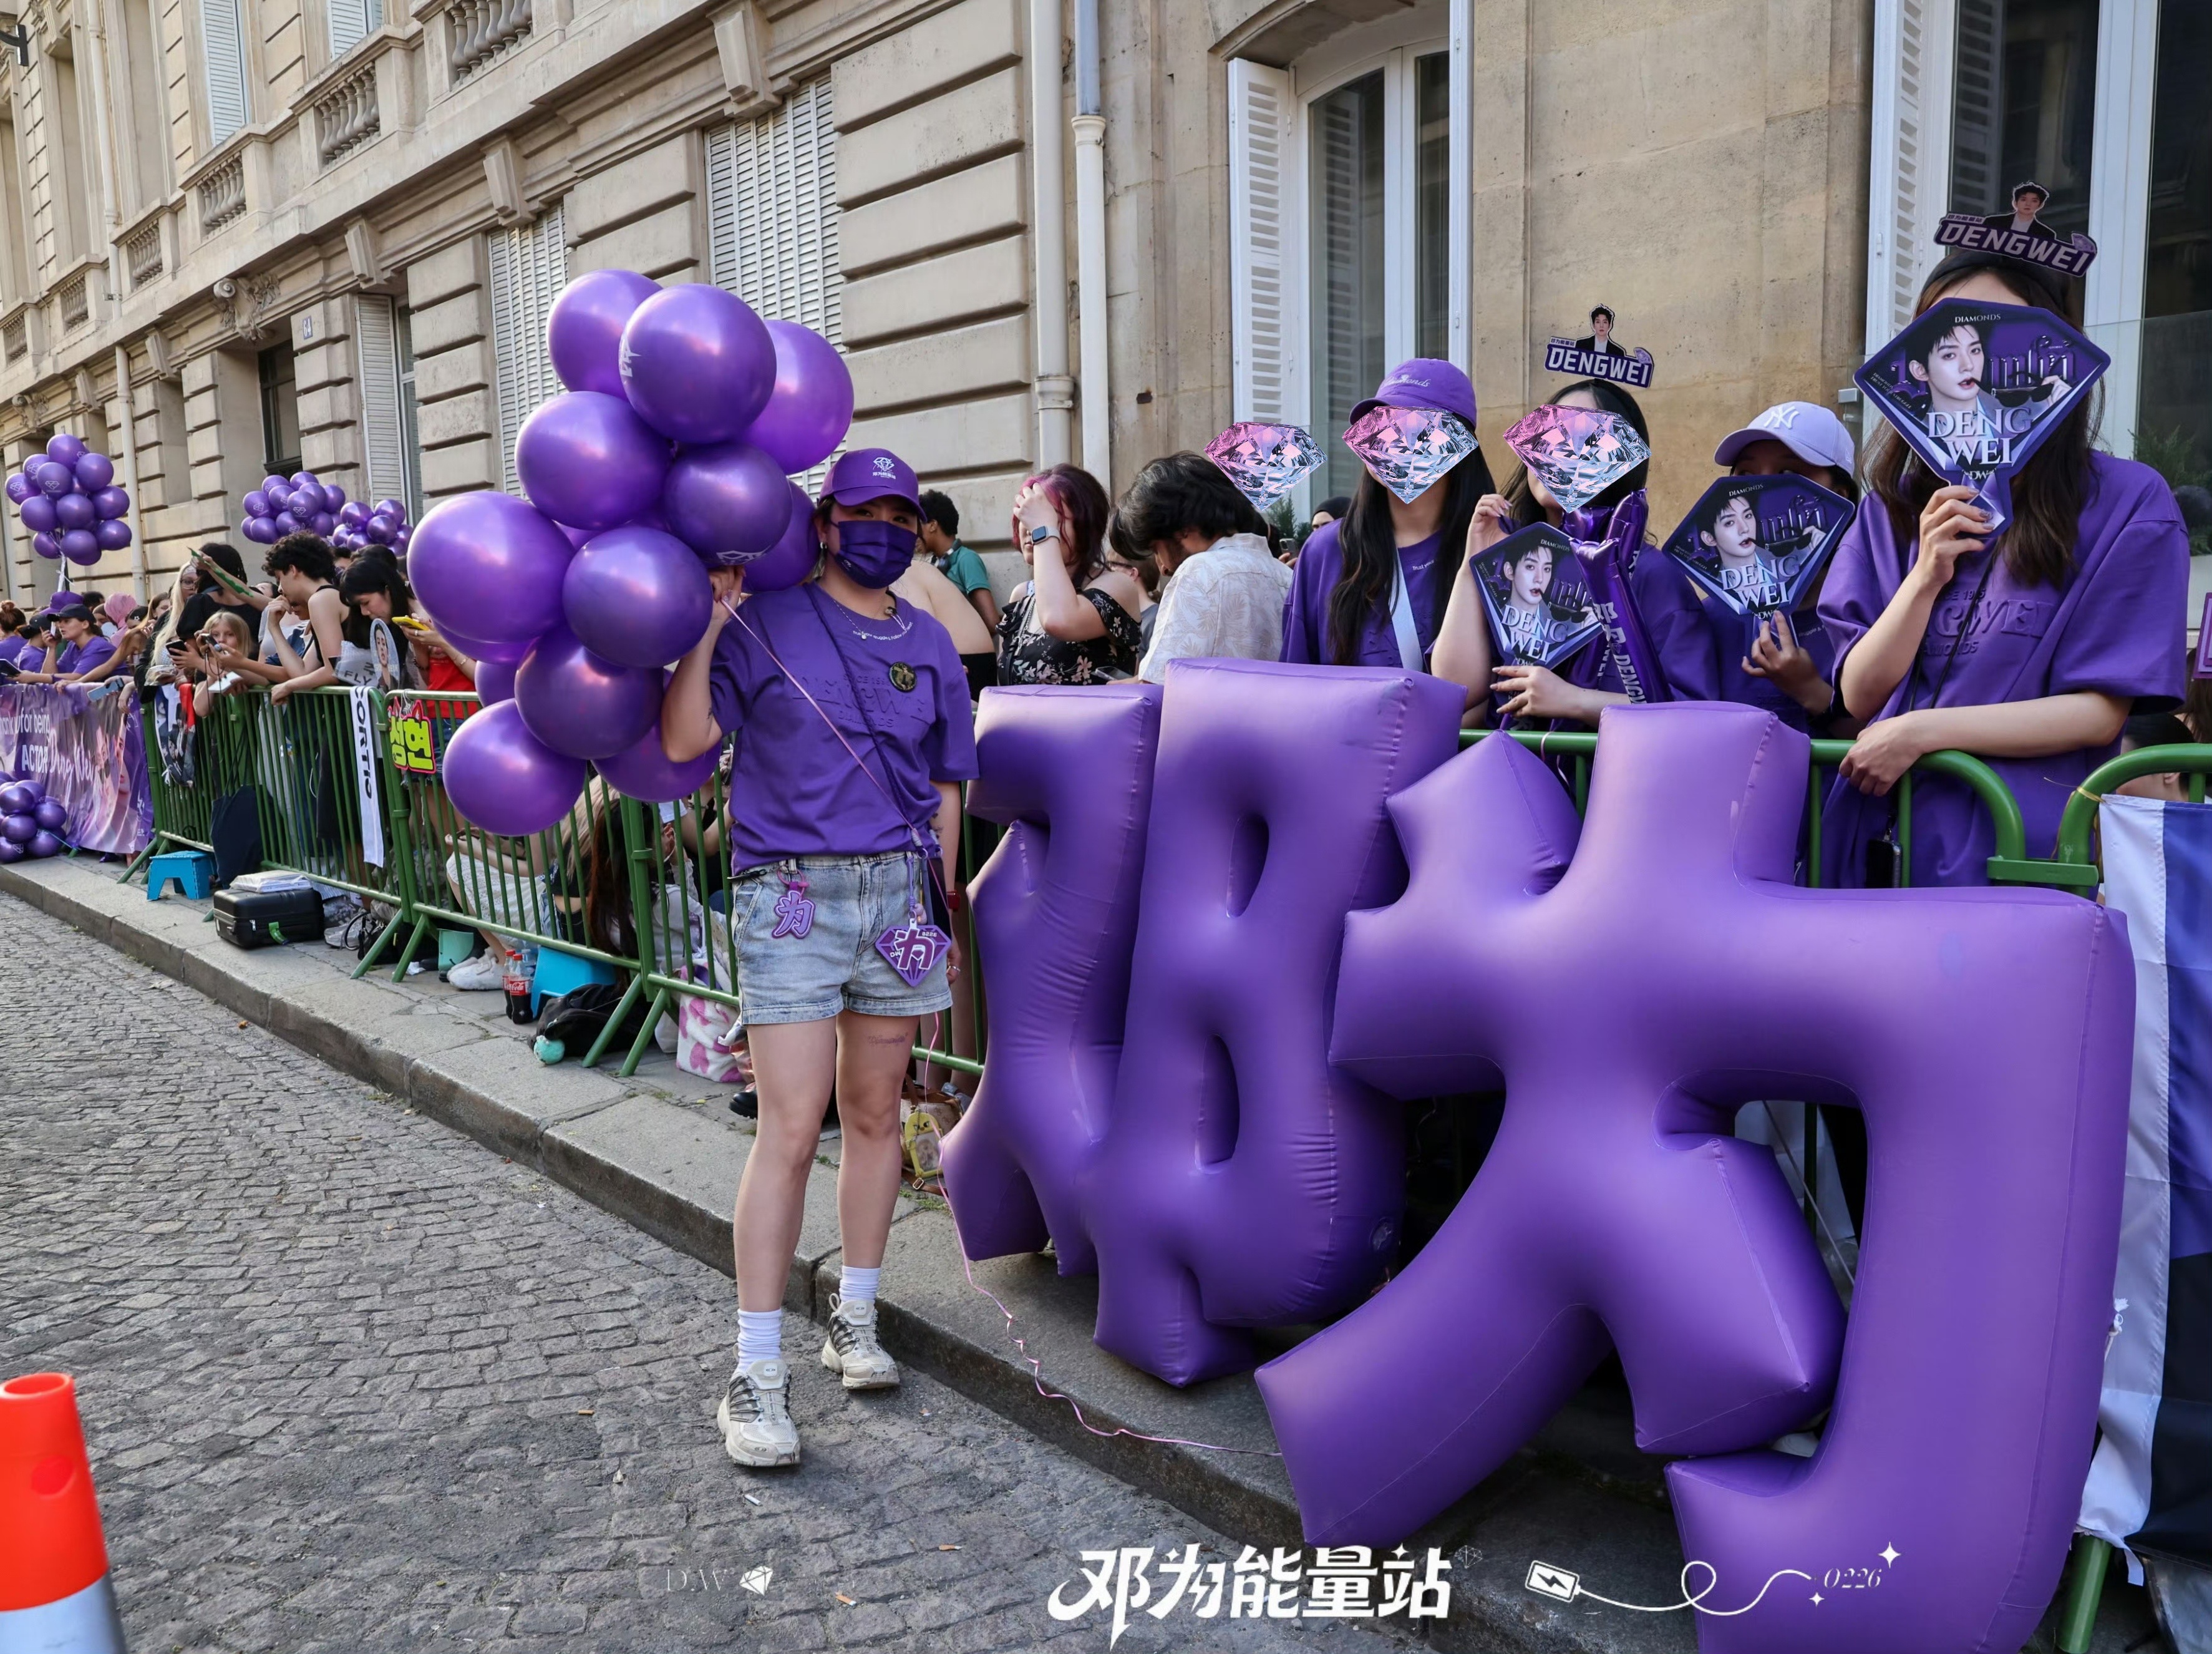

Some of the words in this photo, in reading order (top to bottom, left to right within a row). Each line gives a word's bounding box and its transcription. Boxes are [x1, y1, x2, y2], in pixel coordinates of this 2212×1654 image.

[1941, 223, 2089, 273] DENGWEI
[303, 318, 311, 337] 64
[1955, 313, 2001, 323] DIAMONDS
[1548, 347, 1649, 385] DENGWEI
[1927, 407, 2032, 439] DENG
[1945, 437, 2014, 465] WEI
[1729, 484, 1764, 497] DIAMONDS
[1540, 538, 1571, 552] DIAMONDS
[1720, 556, 1800, 591] DENG
[1735, 581, 1790, 610] WEI
[1501, 604, 1569, 643] DENG
[1510, 629, 1552, 663] WEI
[344, 669, 372, 686] FLY
[21, 707, 32, 733] for
[33, 708, 50, 743] being
[22, 744, 48, 774] ACTOR
[389, 715, 434, 771] 성현
[773, 891, 815, 937] 为
